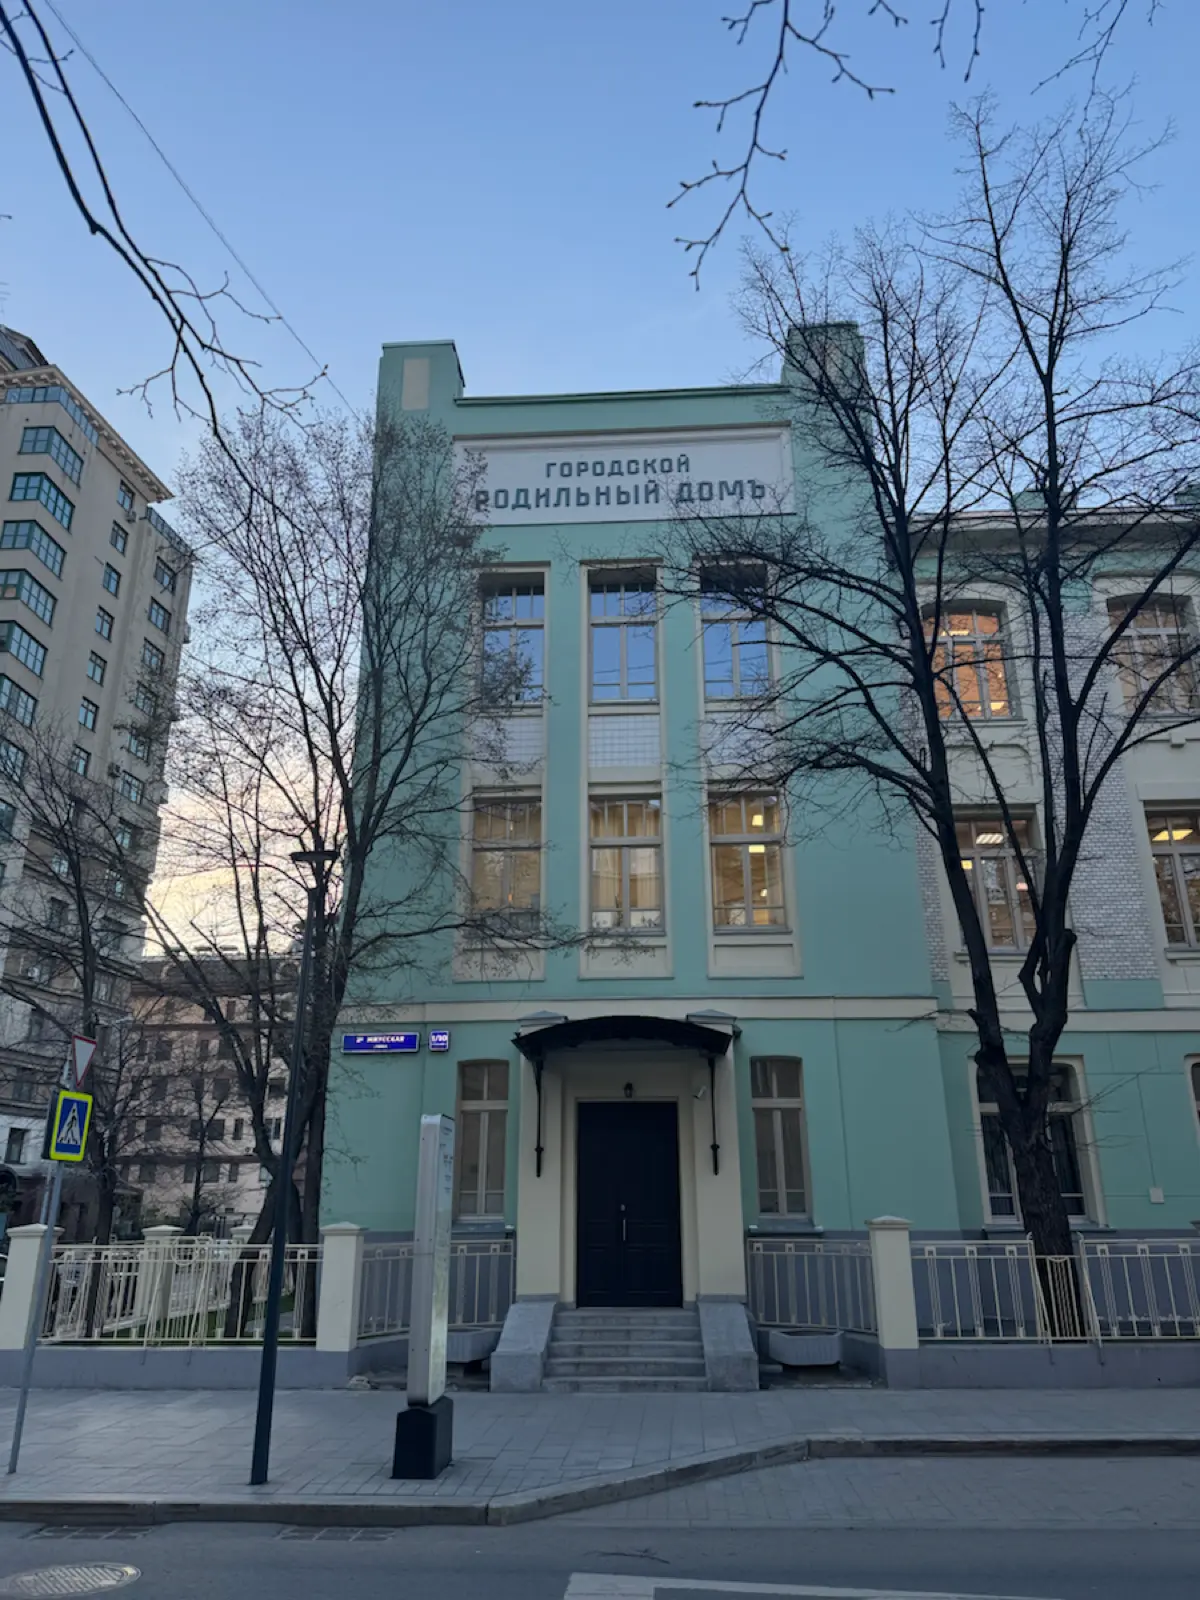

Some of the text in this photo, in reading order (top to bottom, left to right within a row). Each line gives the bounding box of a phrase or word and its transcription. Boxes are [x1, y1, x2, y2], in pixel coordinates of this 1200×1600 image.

[546, 454, 691, 478] ГОРОДСКОЙ
[475, 479, 767, 512] РОДИЛЬНЫЙ ДОМЪ
